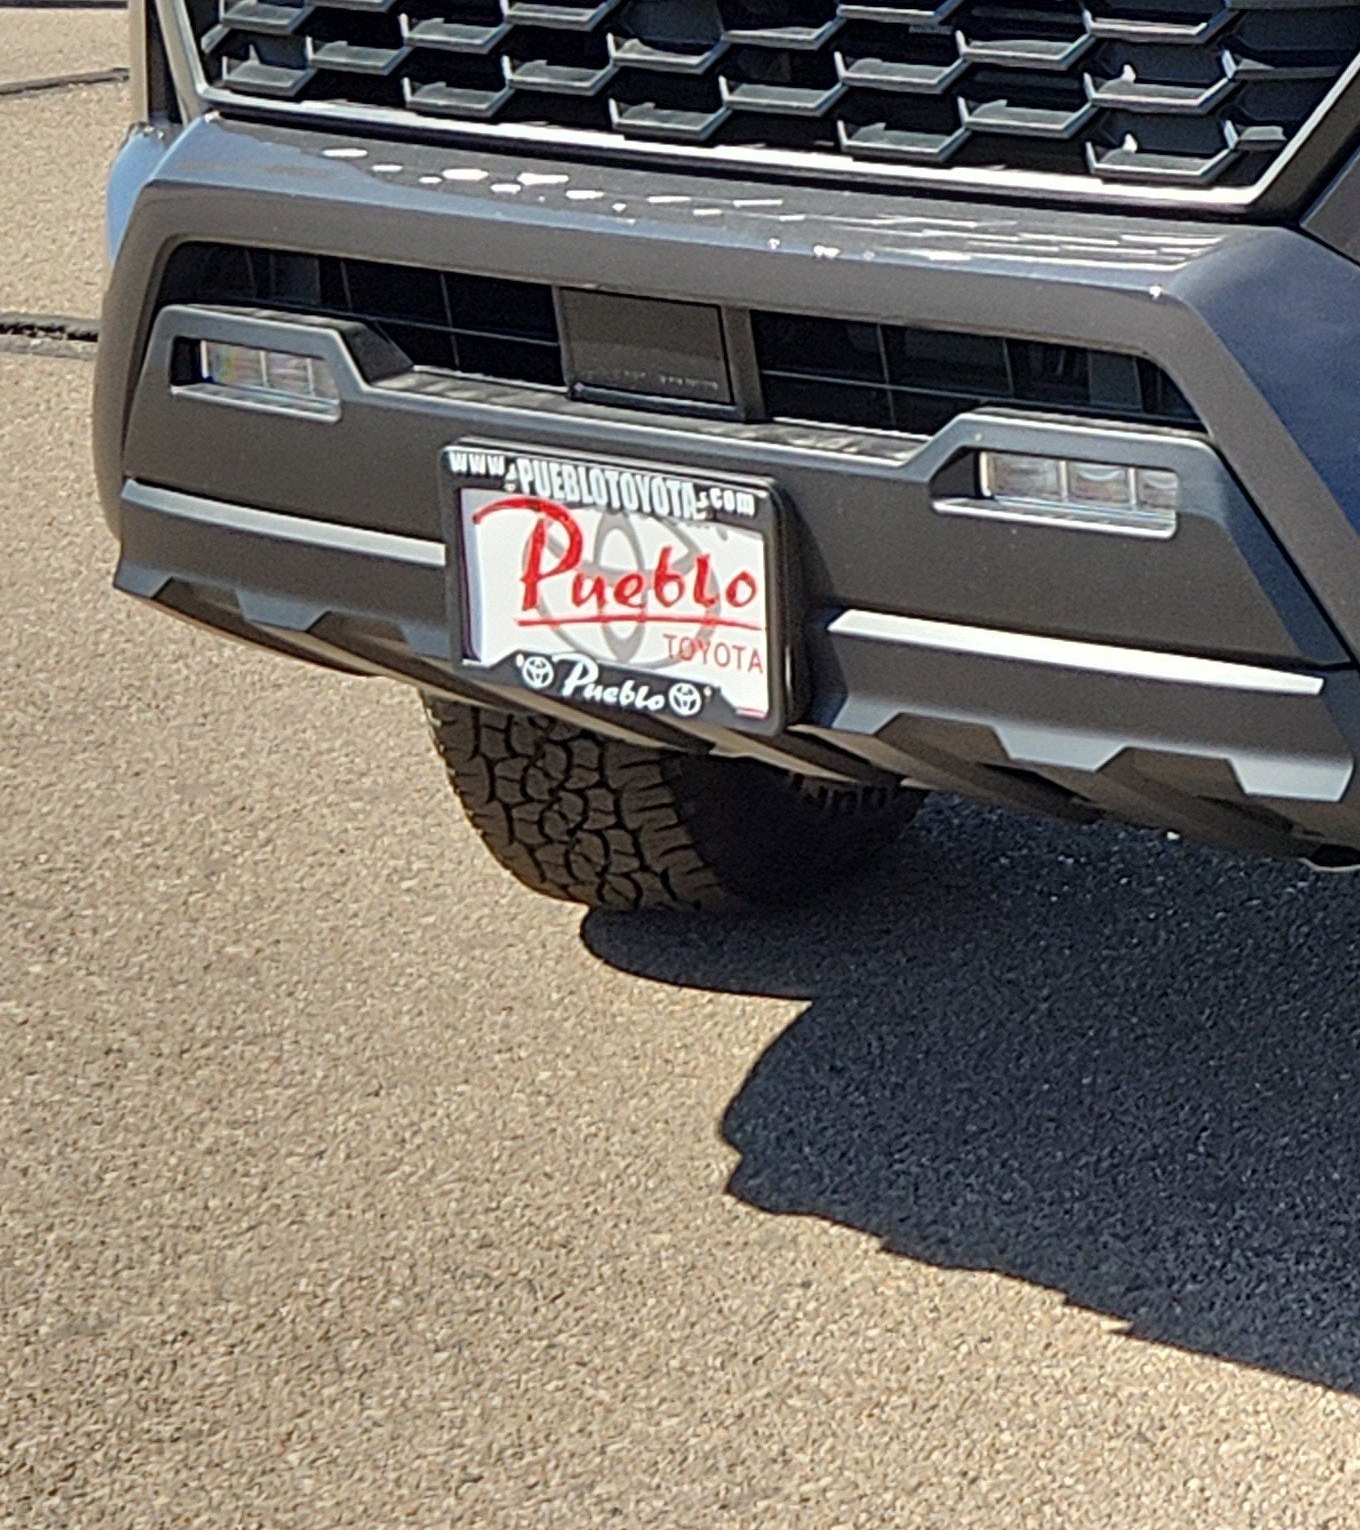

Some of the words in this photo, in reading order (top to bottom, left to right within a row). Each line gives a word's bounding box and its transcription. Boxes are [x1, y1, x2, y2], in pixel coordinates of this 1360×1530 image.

[472, 495, 757, 612] Pueblo
[552, 652, 666, 712] Pueblo
[663, 633, 764, 674] TOYOTA
